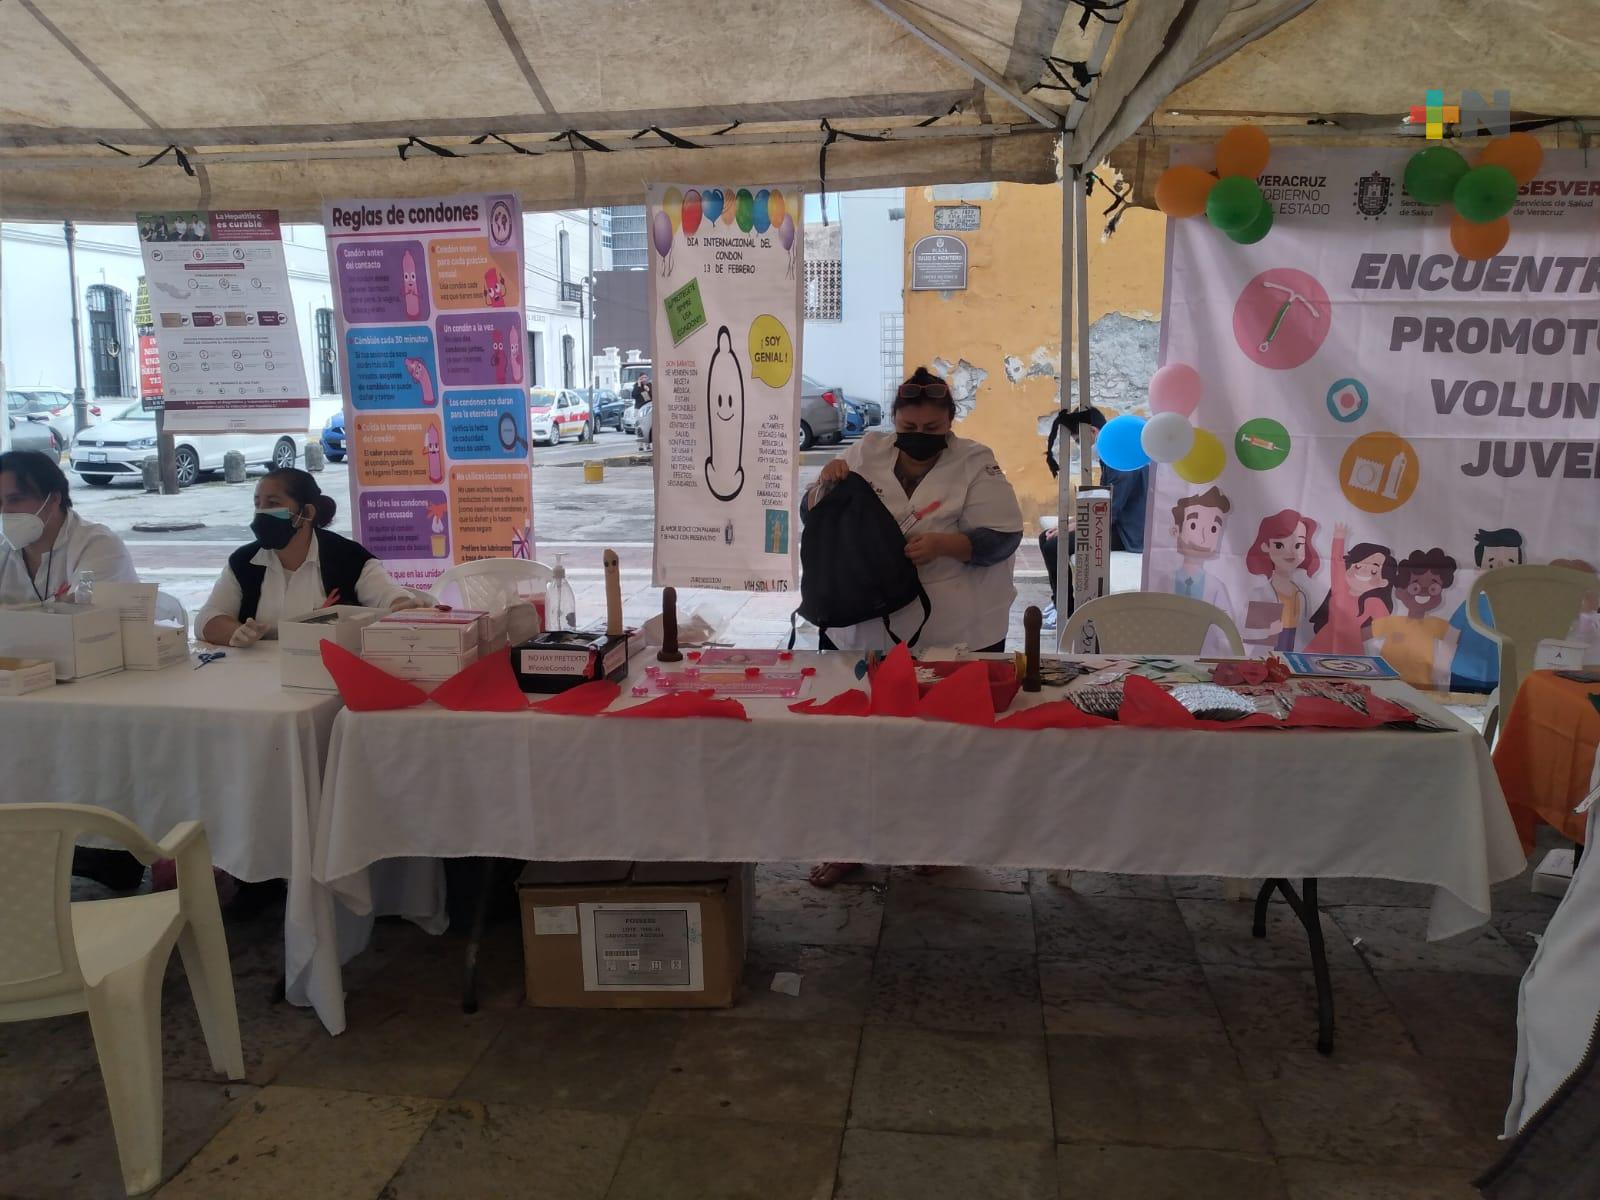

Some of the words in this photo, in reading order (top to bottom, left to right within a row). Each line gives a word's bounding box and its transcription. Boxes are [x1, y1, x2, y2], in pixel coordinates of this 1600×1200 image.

[1256, 175, 1327, 188] VERACRUZ
[1261, 188, 1321, 201] OBIERNO
[1567, 200, 1593, 208] Salud
[1279, 203, 1330, 216] ESTADO
[1526, 208, 1565, 217] Veracruz
[333, 204, 383, 232] Reglas
[386, 204, 405, 225] de
[409, 202, 479, 224] condones
[226, 221, 263, 229] curable
[687, 238, 699, 247] DIA
[703, 238, 756, 248] INTERNACIONAL
[760, 239, 772, 248] DEL
[715, 251, 743, 261] CONDON
[703, 264, 711, 273] 13
[715, 264, 724, 274] DE
[728, 264, 756, 274] FEBRERO
[443, 324, 452, 333] Un
[404, 334, 429, 343] minutos
[1389, 316, 1600, 356] PROMOT
[449, 399, 459, 407] Los
[459, 397, 487, 406] condones
[487, 398, 496, 406] no
[469, 408, 498, 418] eternidad
[1460, 440, 1600, 479] JUVE
[367, 500, 376, 508] No
[376, 499, 390, 508] tires
[368, 512, 379, 520] por
[379, 511, 386, 519] el
[386, 510, 414, 519] excusado
[1076, 503, 1092, 551] TRIPIÉ
[1094, 516, 1104, 568] KAISER
[393, 571, 405, 580] que
[415, 569, 424, 578] las
[554, 655, 587, 663] PRETEXTO
